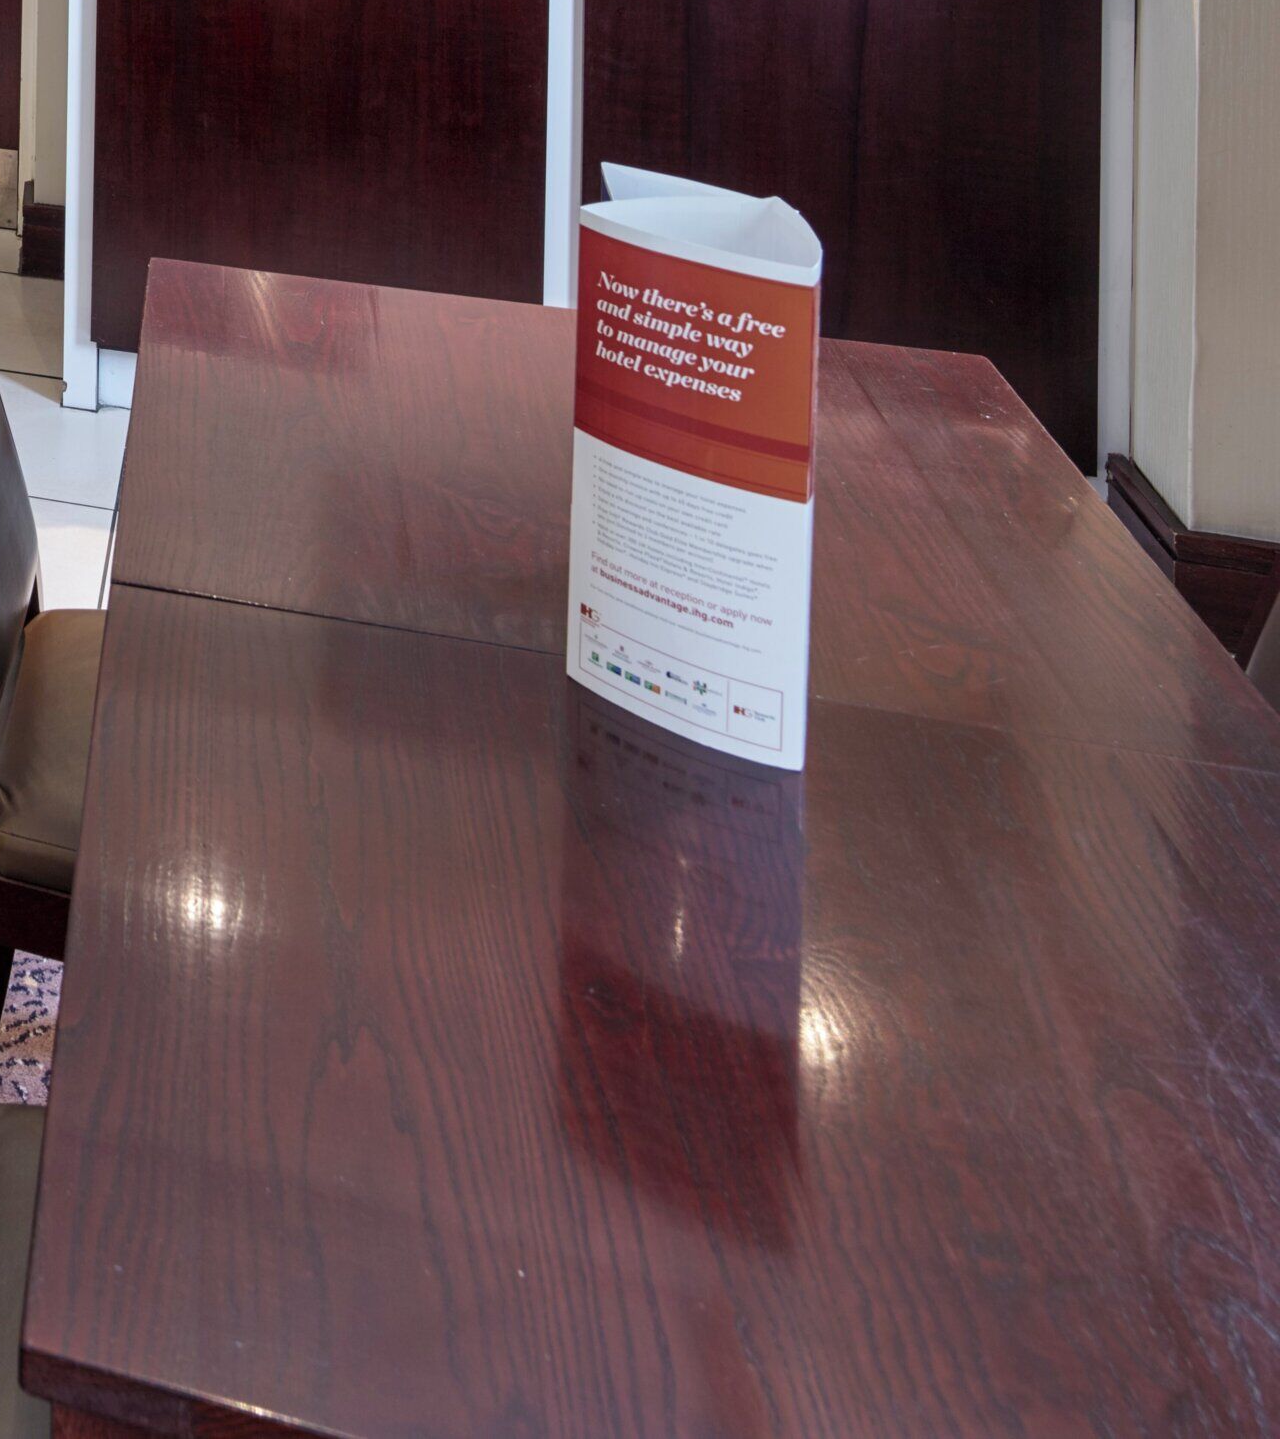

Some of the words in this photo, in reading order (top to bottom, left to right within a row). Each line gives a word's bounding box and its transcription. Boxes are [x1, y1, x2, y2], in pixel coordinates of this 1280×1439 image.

[596, 298, 632, 322] and
[633, 311, 702, 342] simple
[706, 332, 754, 359] way
[597, 270, 640, 300] Now
[642, 288, 714, 322] there's
[717, 312, 733, 327] a
[731, 312, 786, 338] free
[596, 318, 614, 338] to
[616, 330, 697, 366] manage
[698, 356, 755, 380] your
[596, 340, 642, 372] hotel
[644, 364, 742, 402] expenses
[580, 603, 600, 622] IHG
[591, 565, 598, 574] at
[600, 568, 734, 628] businessadvantage.ihg.com
[592, 550, 608, 566] Find
[610, 562, 622, 574] out
[624, 569, 648, 585] more
[650, 580, 658, 589] at
[660, 585, 704, 606] reception
[707, 602, 718, 610] or
[720, 606, 748, 622] apply
[750, 614, 773, 626] now
